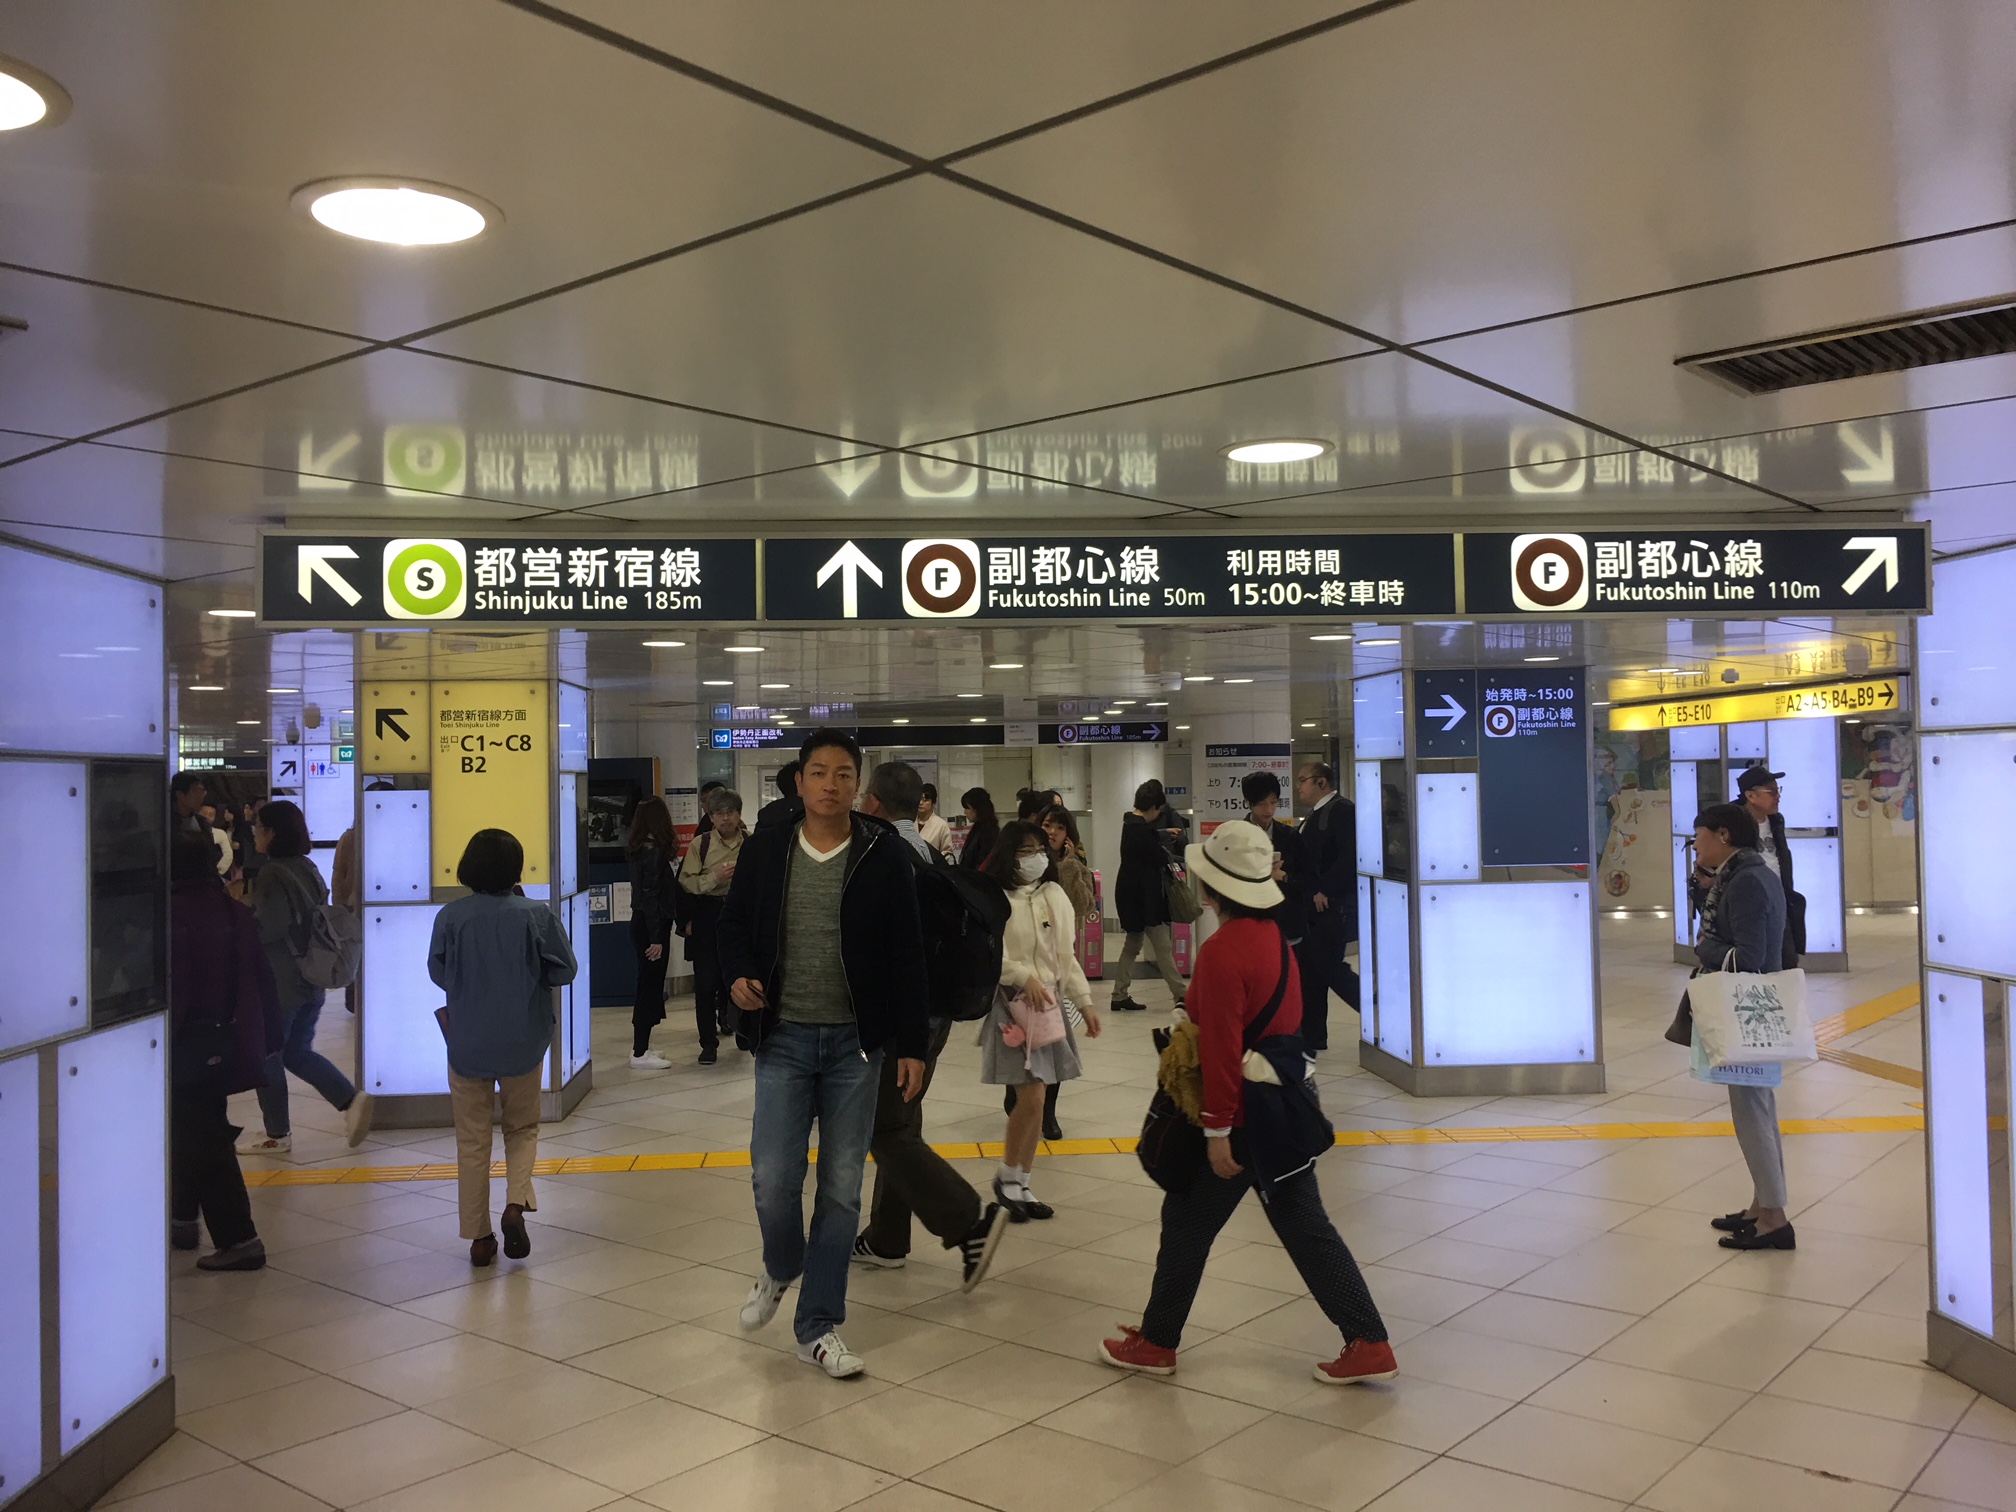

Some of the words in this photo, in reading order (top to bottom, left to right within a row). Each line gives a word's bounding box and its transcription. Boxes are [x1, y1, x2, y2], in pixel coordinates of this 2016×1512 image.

[474, 548, 702, 588] 都営新宿線
[987, 546, 1161, 586] 副都心線
[1227, 549, 1341, 576] 利用時間
[1594, 540, 1764, 579] 副都心線
[988, 588, 1101, 609] Fukutoshin
[1109, 588, 1150, 608] Line
[1164, 589, 1205, 607] 50m
[1595, 581, 1707, 601] Fukutoshin
[1713, 581, 1754, 600] Line
[1768, 582, 1820, 600] 110m
[474, 591, 573, 614] Shinjuku
[583, 591, 627, 610] Line
[644, 592, 702, 610] 185m
[440, 709, 527, 721] 都営新宿線方面
[1517, 706, 1574, 721] 副都心線
[455, 721, 484, 729] Shinjuku
[1079, 725, 1122, 736] 副都心線
[1517, 721, 1559, 729] Fukutoshin
[1560, 720, 1577, 728] Line
[1208, 748, 1238, 756] お知らせ
[461, 755, 487, 774] B2
[1207, 778, 1221, 787] 上り
[1208, 799, 1221, 809] 下り
